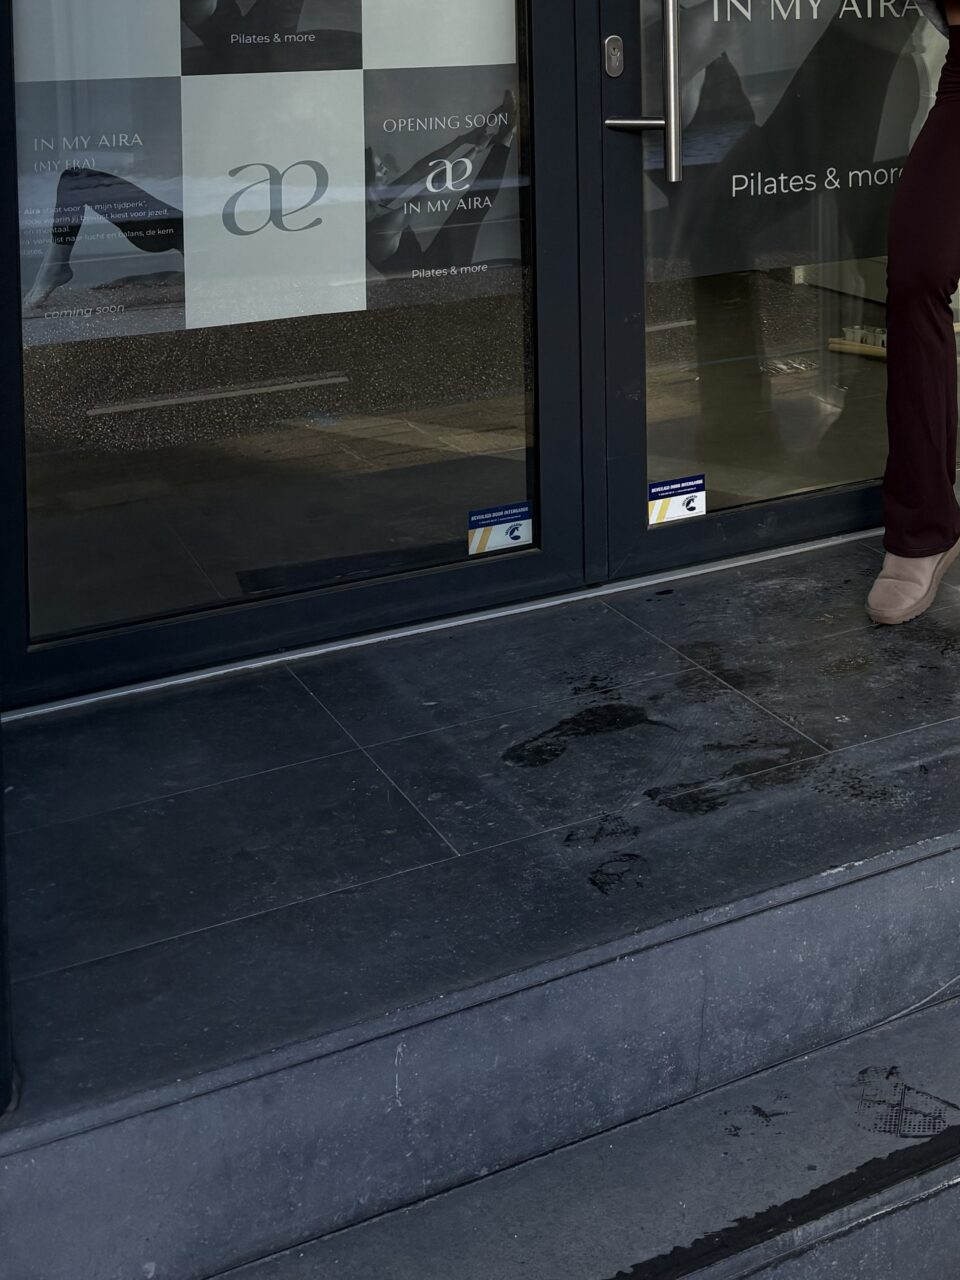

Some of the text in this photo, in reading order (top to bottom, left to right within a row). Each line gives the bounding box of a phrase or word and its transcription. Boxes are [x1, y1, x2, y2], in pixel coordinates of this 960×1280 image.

[230, 32, 315, 44] Pilates & more
[383, 111, 509, 133] OPENING SOON
[34, 133, 143, 152] IN MY AIRA
[732, 170, 817, 198] Pilates
[824, 167, 840, 189] &
[94, 204, 113, 212] mijn
[404, 196, 493, 214] IN MY AIRA
[411, 265, 488, 280] Pilates & more
[44, 304, 125, 319] coming soon
